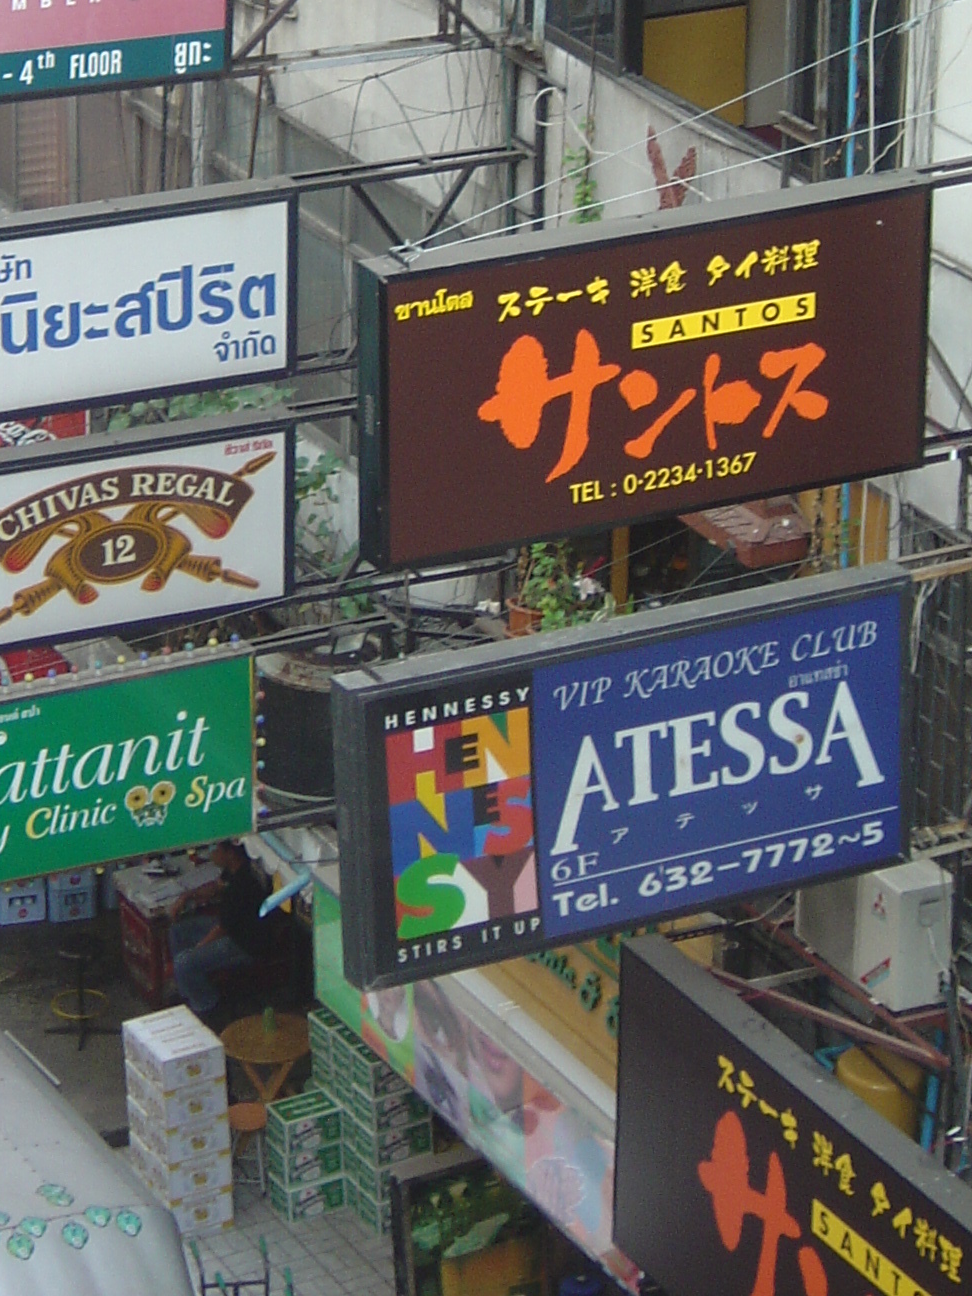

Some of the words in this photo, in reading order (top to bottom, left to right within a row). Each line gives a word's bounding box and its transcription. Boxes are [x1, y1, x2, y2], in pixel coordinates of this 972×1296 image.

[69, 49, 122, 80] FLOOR
[497, 276, 611, 322] ステーキ
[630, 261, 688, 299] 洋食
[706, 238, 822, 282] タイ料理
[641, 298, 810, 344] SANTOS
[213, 330, 276, 362] จำกัด
[477, 328, 829, 484] サントス
[130, 472, 236, 506] REGAL
[569, 480, 604, 504] TEL
[101, 534, 137, 567] 12
[554, 675, 614, 712] VIP
[623, 641, 780, 699] KARAOKE
[791, 619, 879, 663] CLUB
[384, 686, 530, 730] HENNESSY
[550, 680, 885, 856] ATESSA
[24, 798, 119, 841] Clinic
[184, 775, 248, 813] Spa
[551, 851, 600, 882] 6F
[553, 883, 619, 918] Tel.
[397, 935, 464, 964] STIRS
[480, 926, 503, 946] IT
[514, 917, 542, 937] UP
